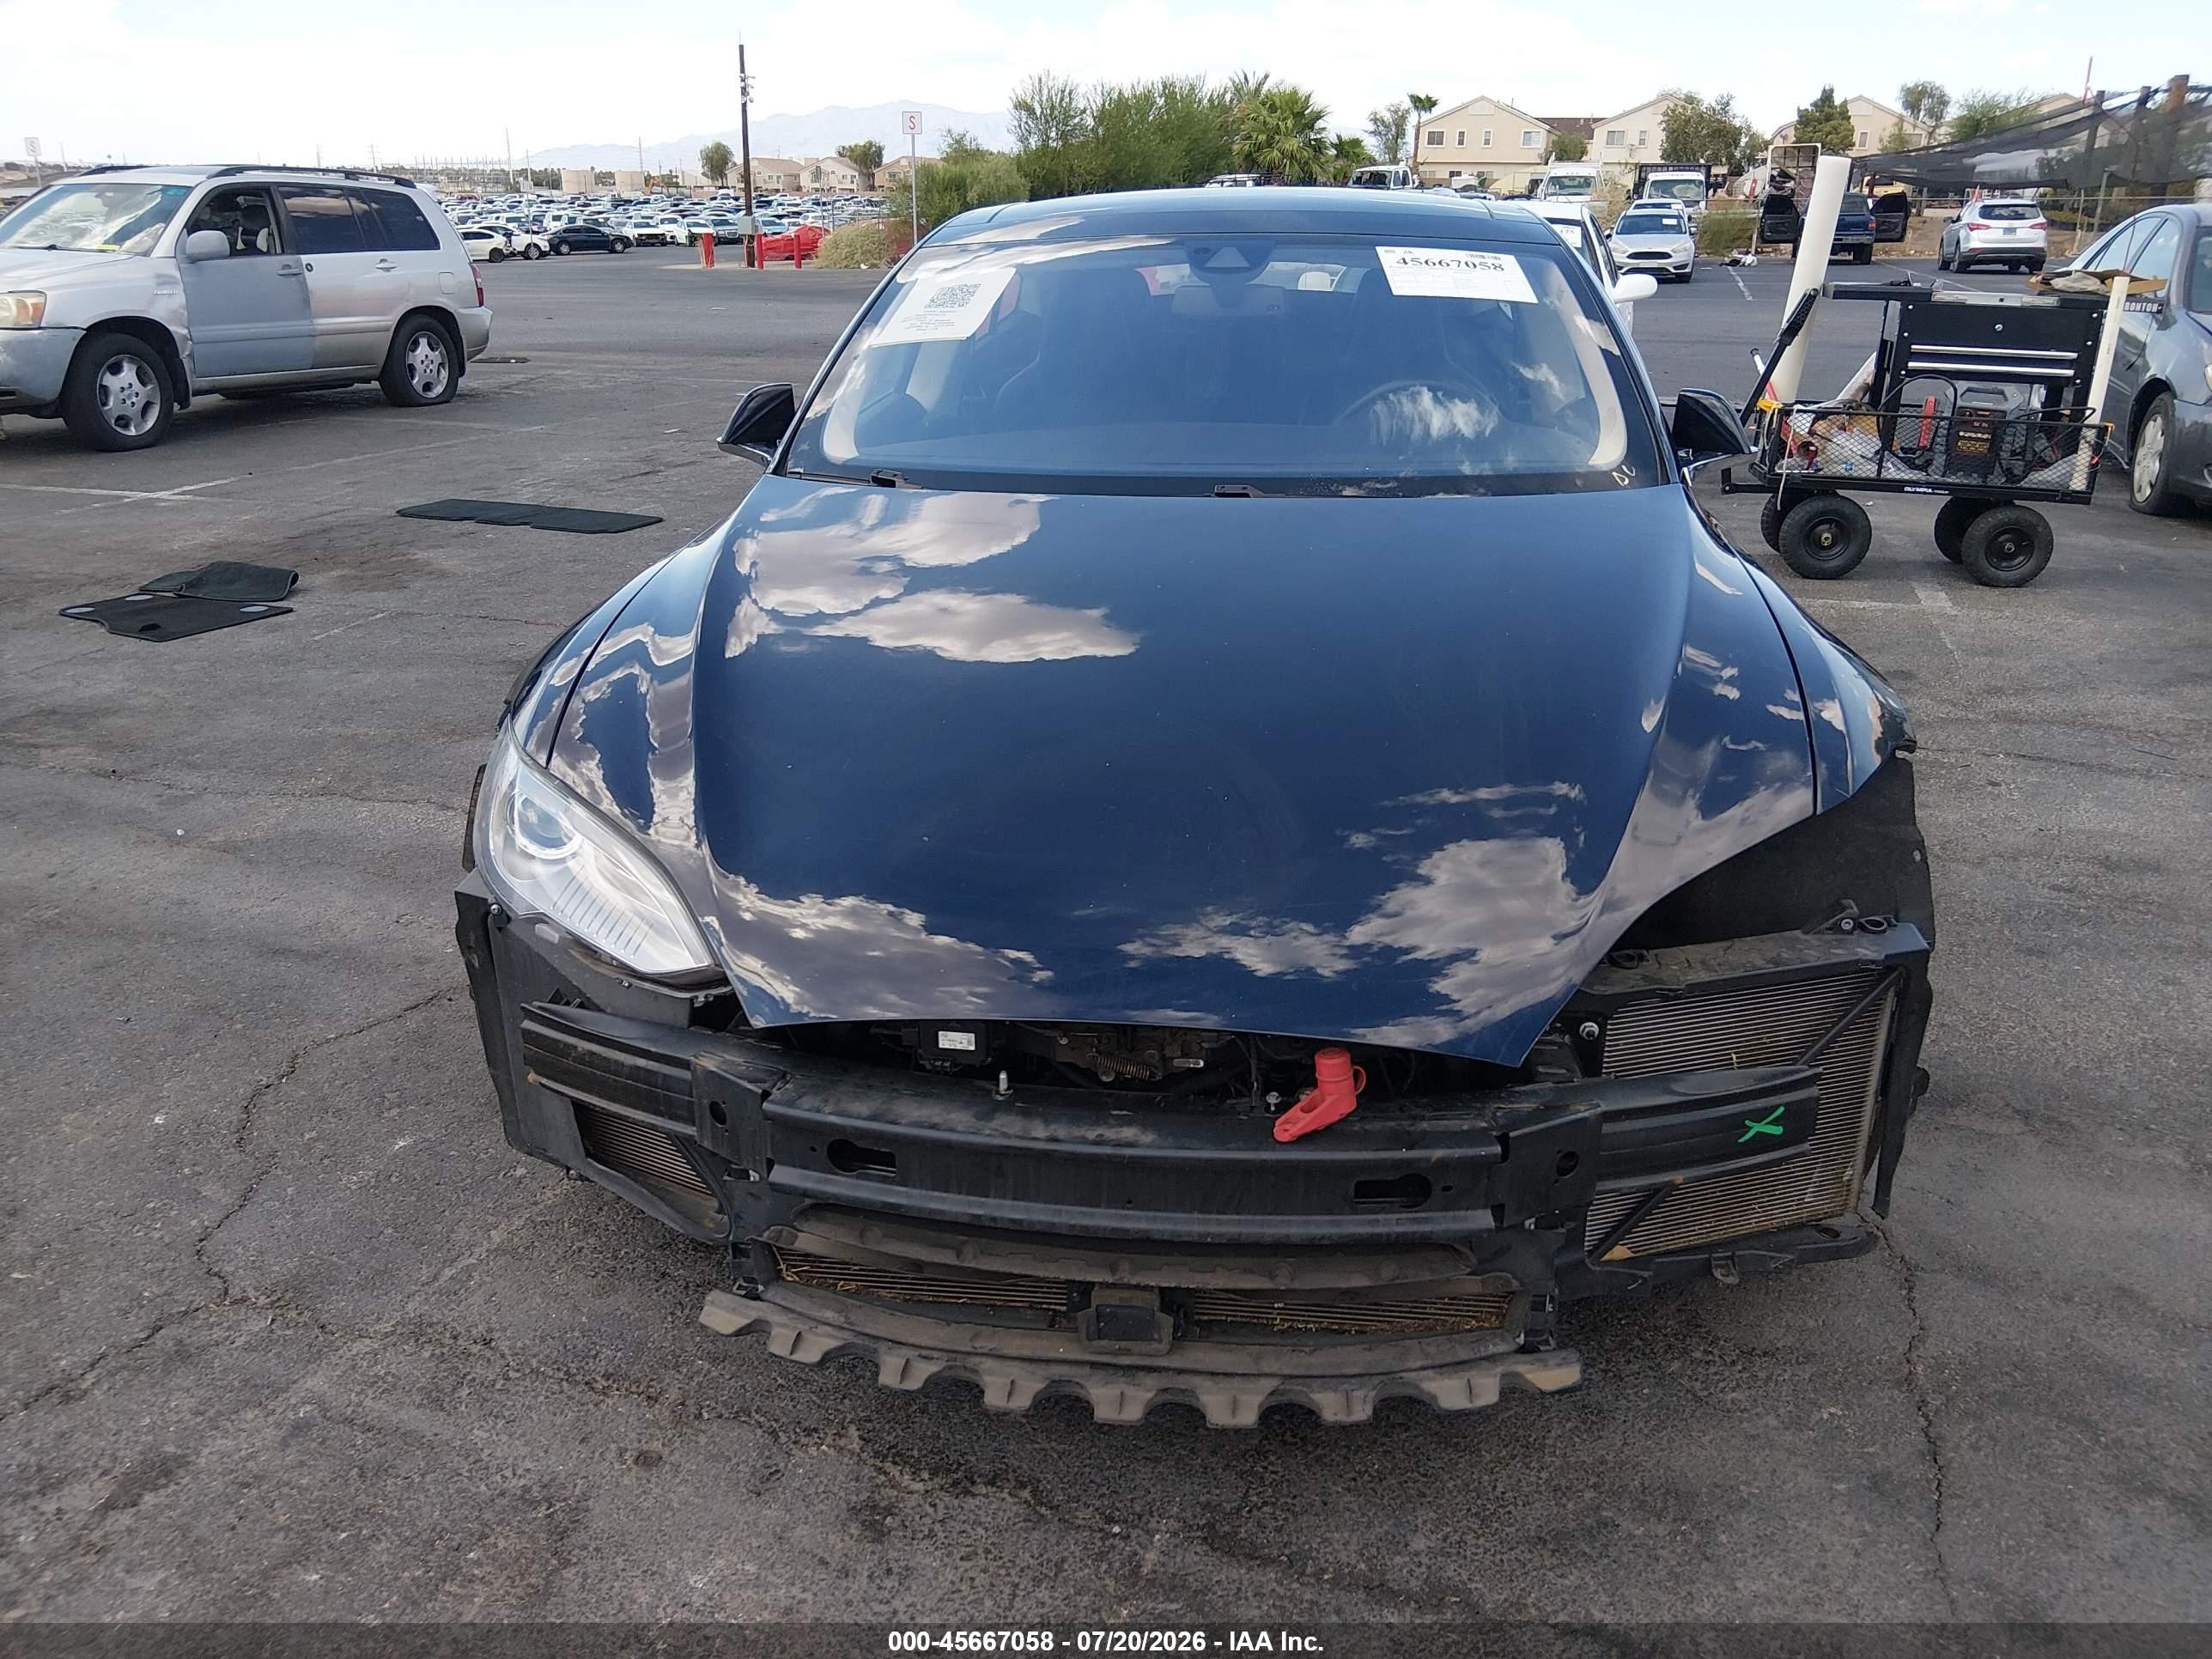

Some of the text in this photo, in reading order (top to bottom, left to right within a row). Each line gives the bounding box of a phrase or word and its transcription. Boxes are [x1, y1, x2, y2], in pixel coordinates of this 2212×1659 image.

[908, 115, 916, 131] S
[1396, 257, 1505, 272] 45667058
[2124, 301, 2159, 313] RONTON
